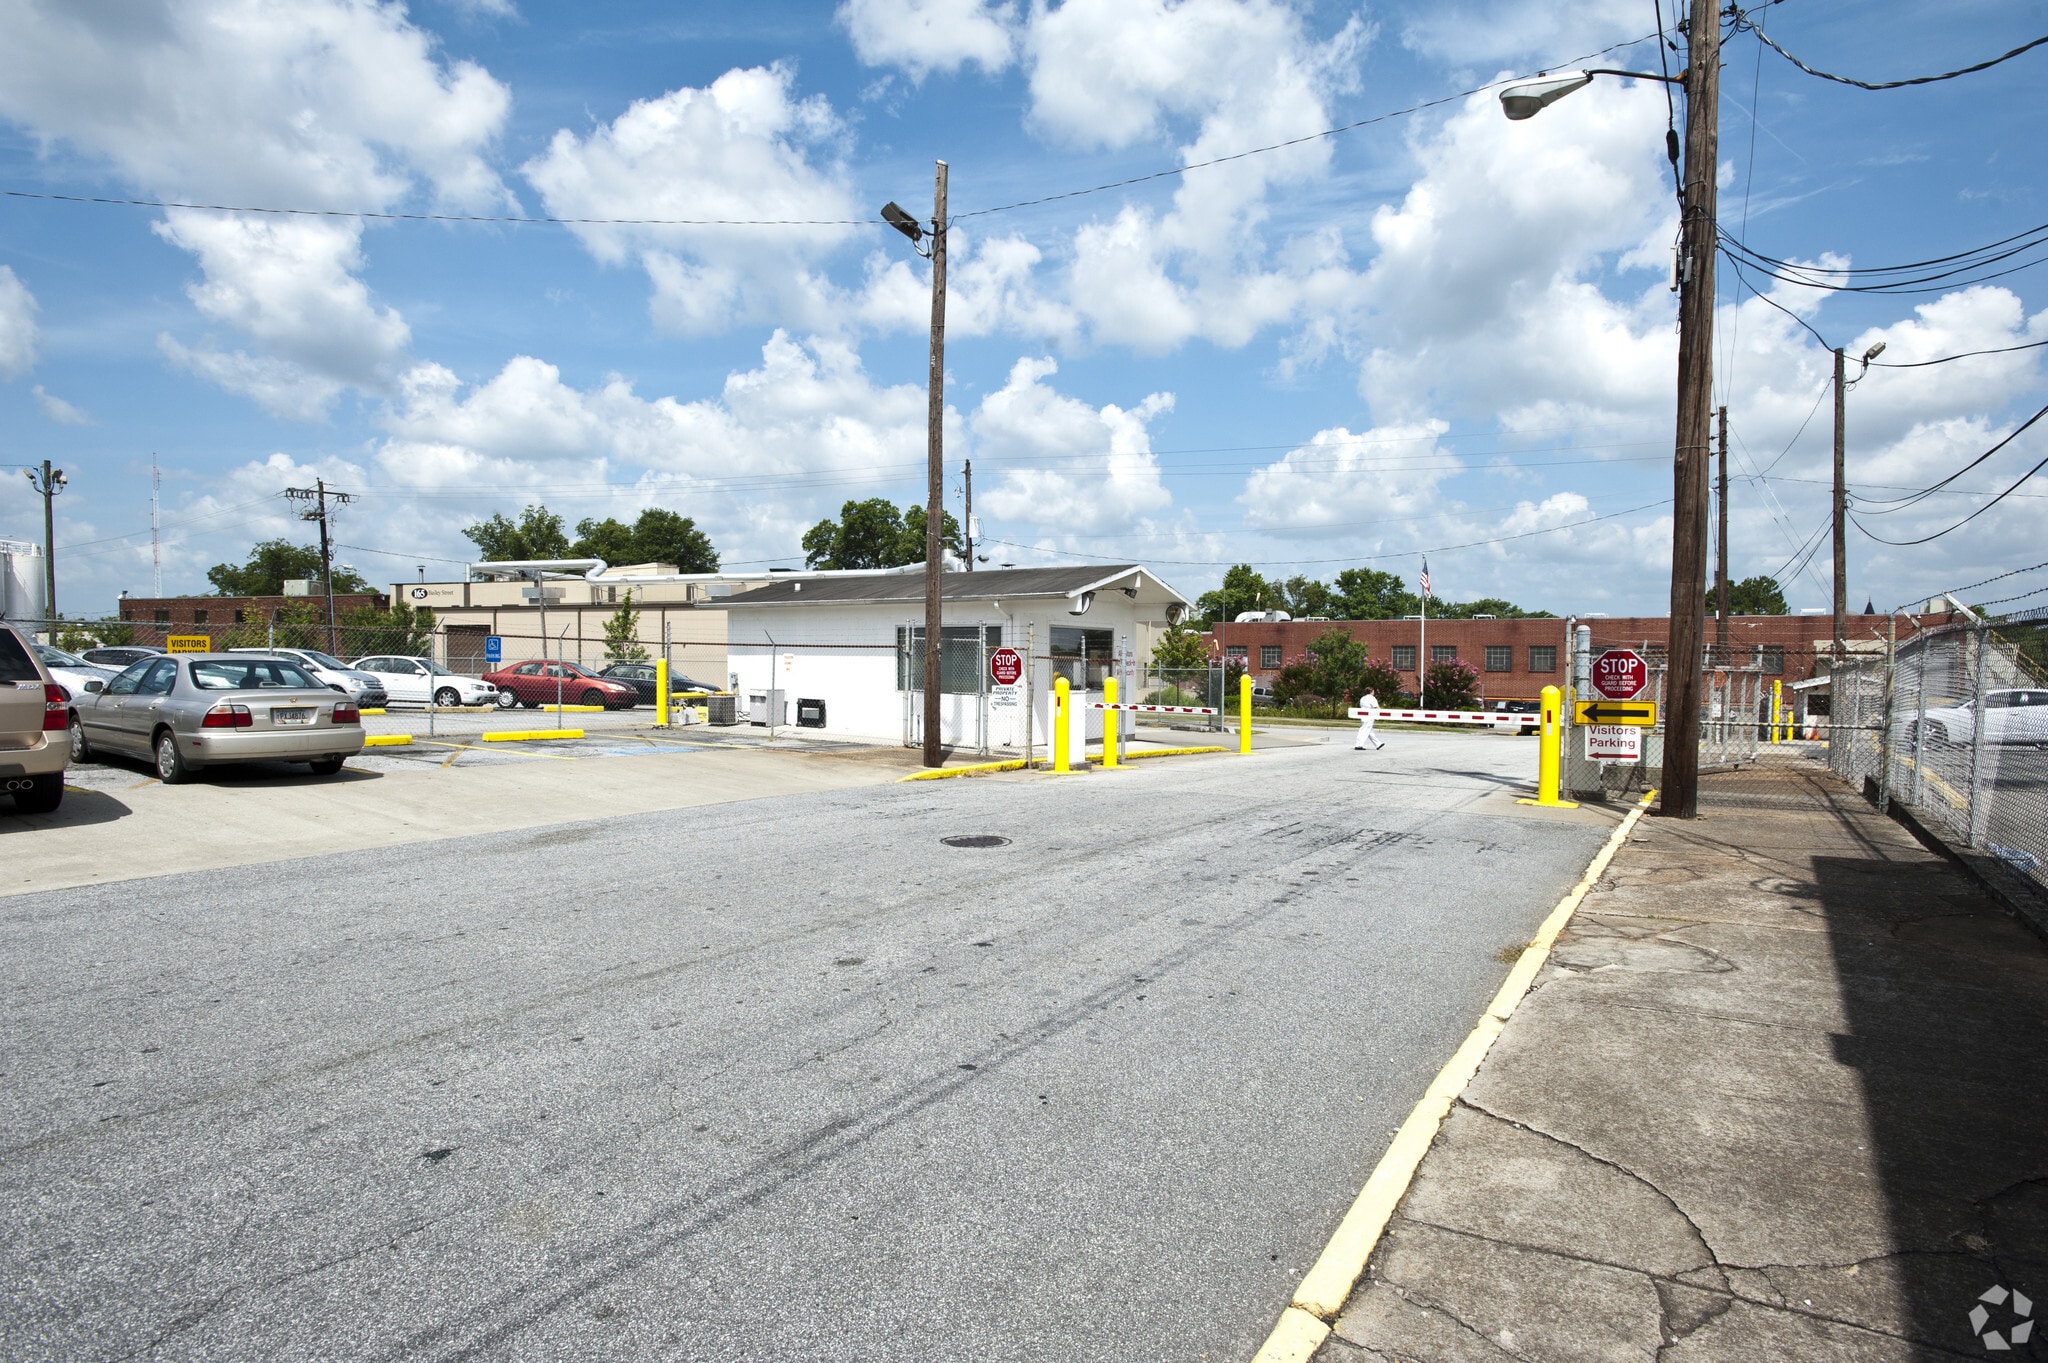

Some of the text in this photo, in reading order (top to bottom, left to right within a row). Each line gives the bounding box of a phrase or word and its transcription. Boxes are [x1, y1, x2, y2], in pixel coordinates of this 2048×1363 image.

[414, 589, 426, 598] 165
[171, 640, 207, 648] VISITORS
[996, 654, 1017, 666] STOP
[1600, 658, 1638, 673] STOP
[1590, 726, 1636, 734] Visitors
[1590, 738, 1635, 749] Parking
